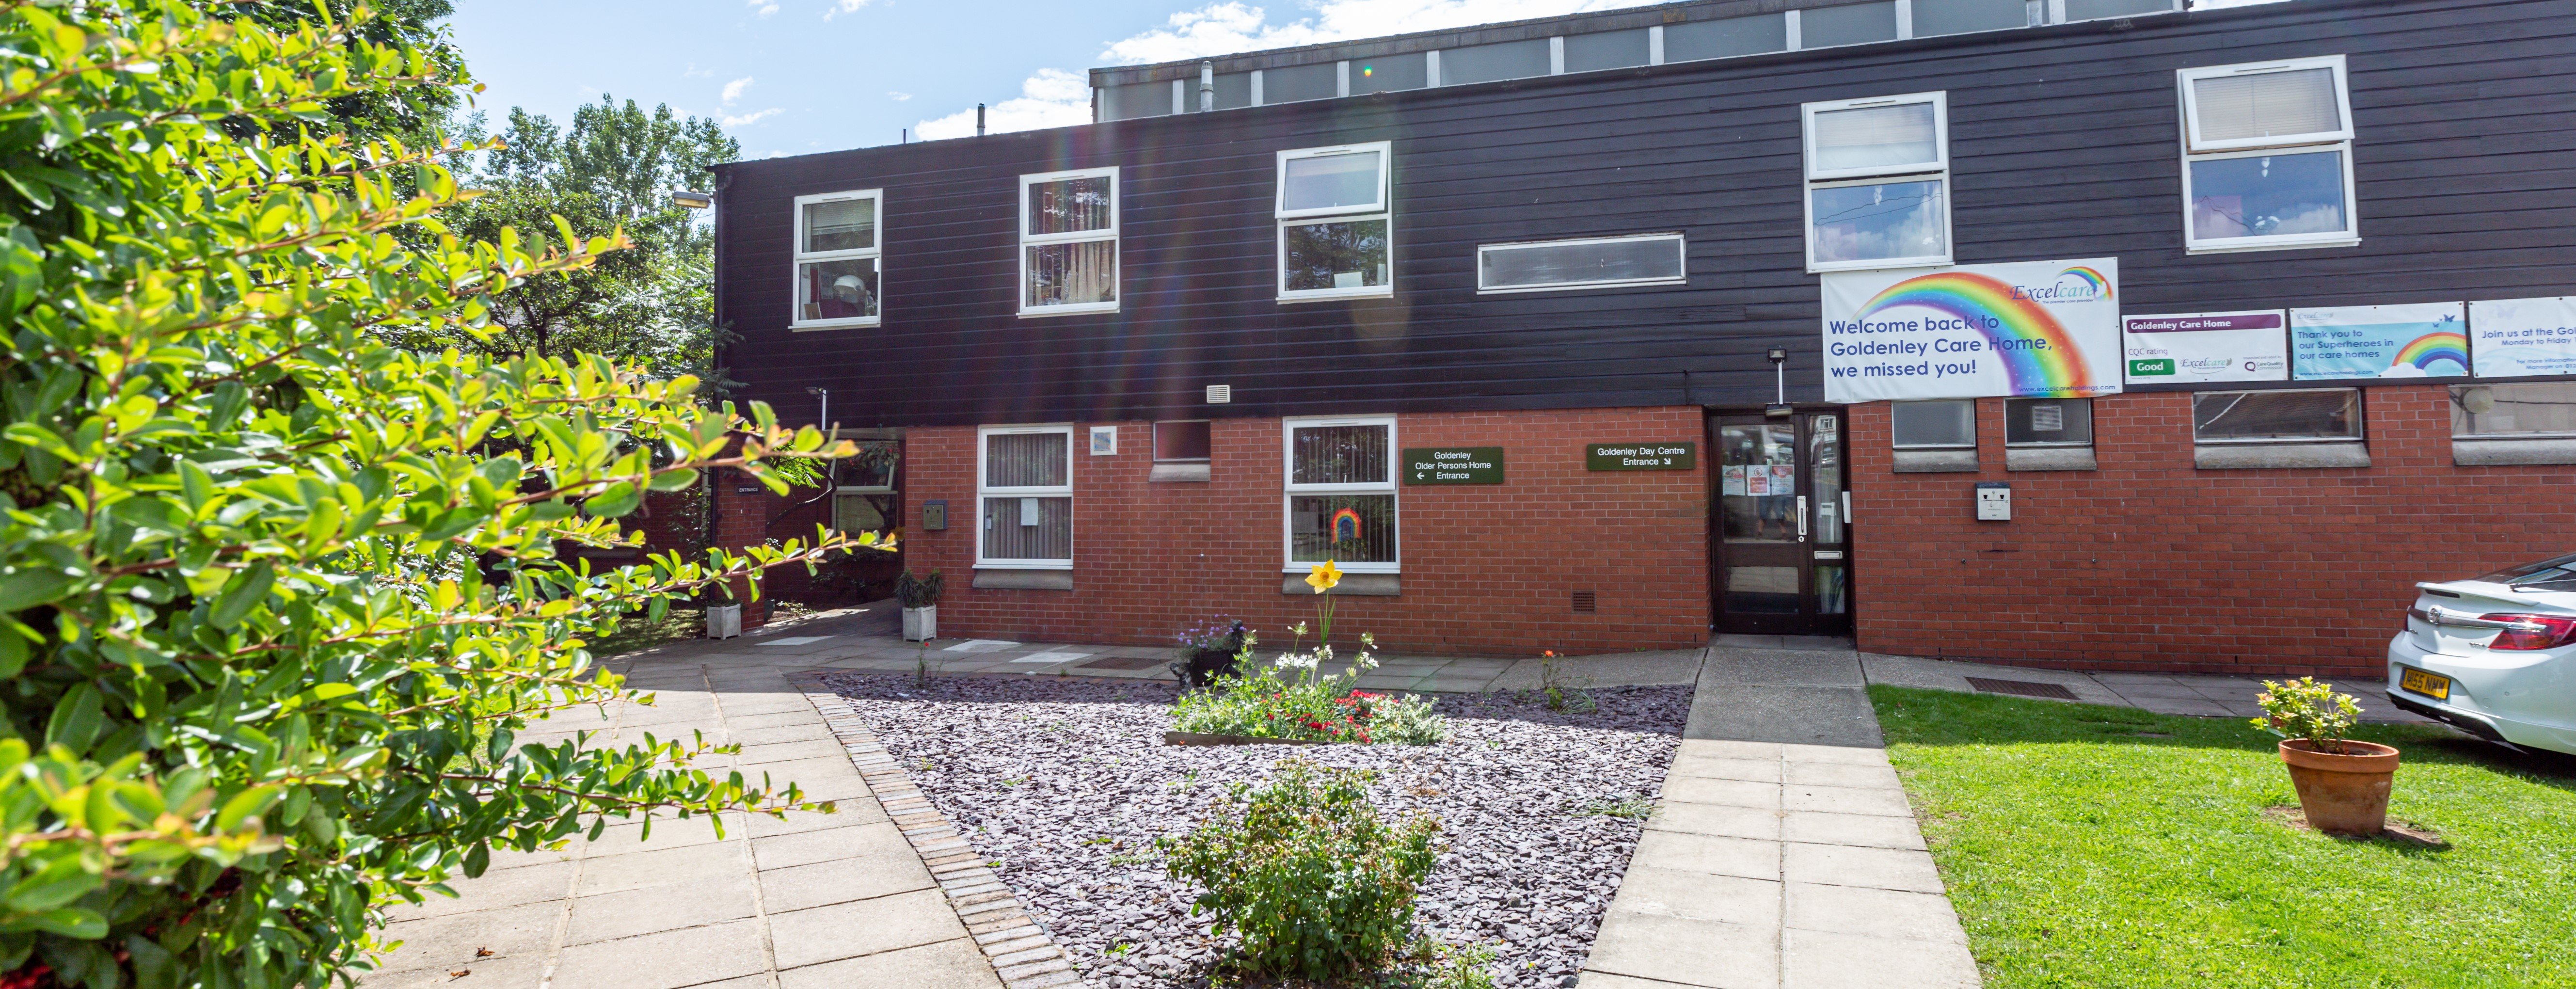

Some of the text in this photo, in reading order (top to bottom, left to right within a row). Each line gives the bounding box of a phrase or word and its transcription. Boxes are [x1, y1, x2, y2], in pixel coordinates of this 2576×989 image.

[2010, 281, 2094, 302] Excelcare
[1830, 315, 1999, 335] Welcome back to
[2131, 321, 2177, 330] Goldenley
[2482, 330, 2503, 338] Join
[1830, 336, 2052, 357] Goldenley Care Home,
[2318, 340, 2382, 350] Superheroes
[2128, 348, 2168, 356] CQC rating
[2137, 362, 2163, 371] Good
[2180, 357, 2226, 368] Excelcare
[1831, 359, 1976, 378] we missed you!
[1434, 452, 1471, 460] Goldenley
[1597, 448, 1637, 457] Goldenley
[1639, 447, 1655, 457] Day
